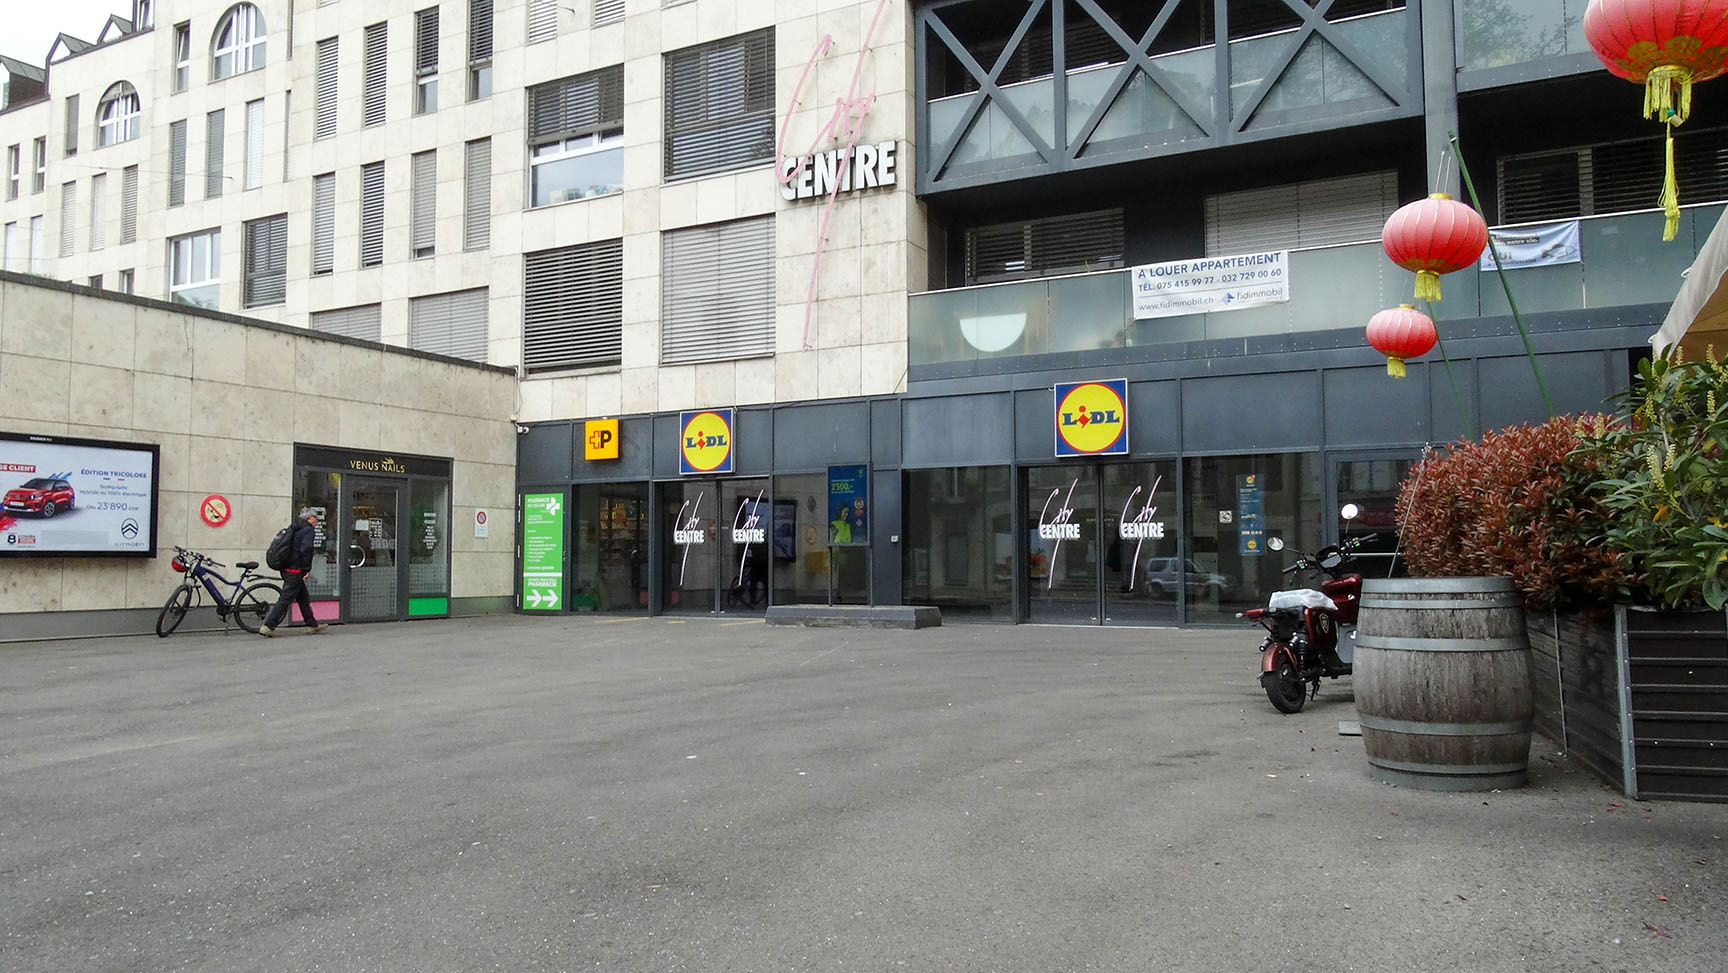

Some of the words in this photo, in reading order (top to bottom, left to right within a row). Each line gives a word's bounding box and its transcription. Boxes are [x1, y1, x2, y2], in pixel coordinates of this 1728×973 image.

[780, 140, 898, 202] CENTRE
[1149, 263, 1188, 278] LOUER
[1191, 252, 1281, 272] APPARTEMENT
[1156, 281, 1172, 290] 075
[1174, 279, 1190, 288] 415
[1191, 277, 1202, 286] 99
[1204, 276, 1215, 284] 77
[1221, 273, 1237, 283] 032
[1240, 271, 1255, 280] 729
[1257, 270, 1269, 279] 00
[1270, 268, 1282, 277] 60
[1138, 297, 1214, 311] www.fidimmobil.ch
[1236, 287, 1283, 301] fidimmobil
[80, 467, 109, 476] ÉDITION
[349, 459, 379, 471] VENUS
[381, 461, 406, 473] NAILS
[97, 501, 128, 511] 23'890
[673, 529, 705, 545] CENTRE
[673, 490, 704, 587] City
[732, 488, 764, 587] City
[733, 528, 765, 544] CENTRE
[1038, 477, 1079, 591] City
[1039, 523, 1081, 539] CENTRE
[1120, 474, 1162, 592] City
[1121, 522, 1165, 538] CENTRE
